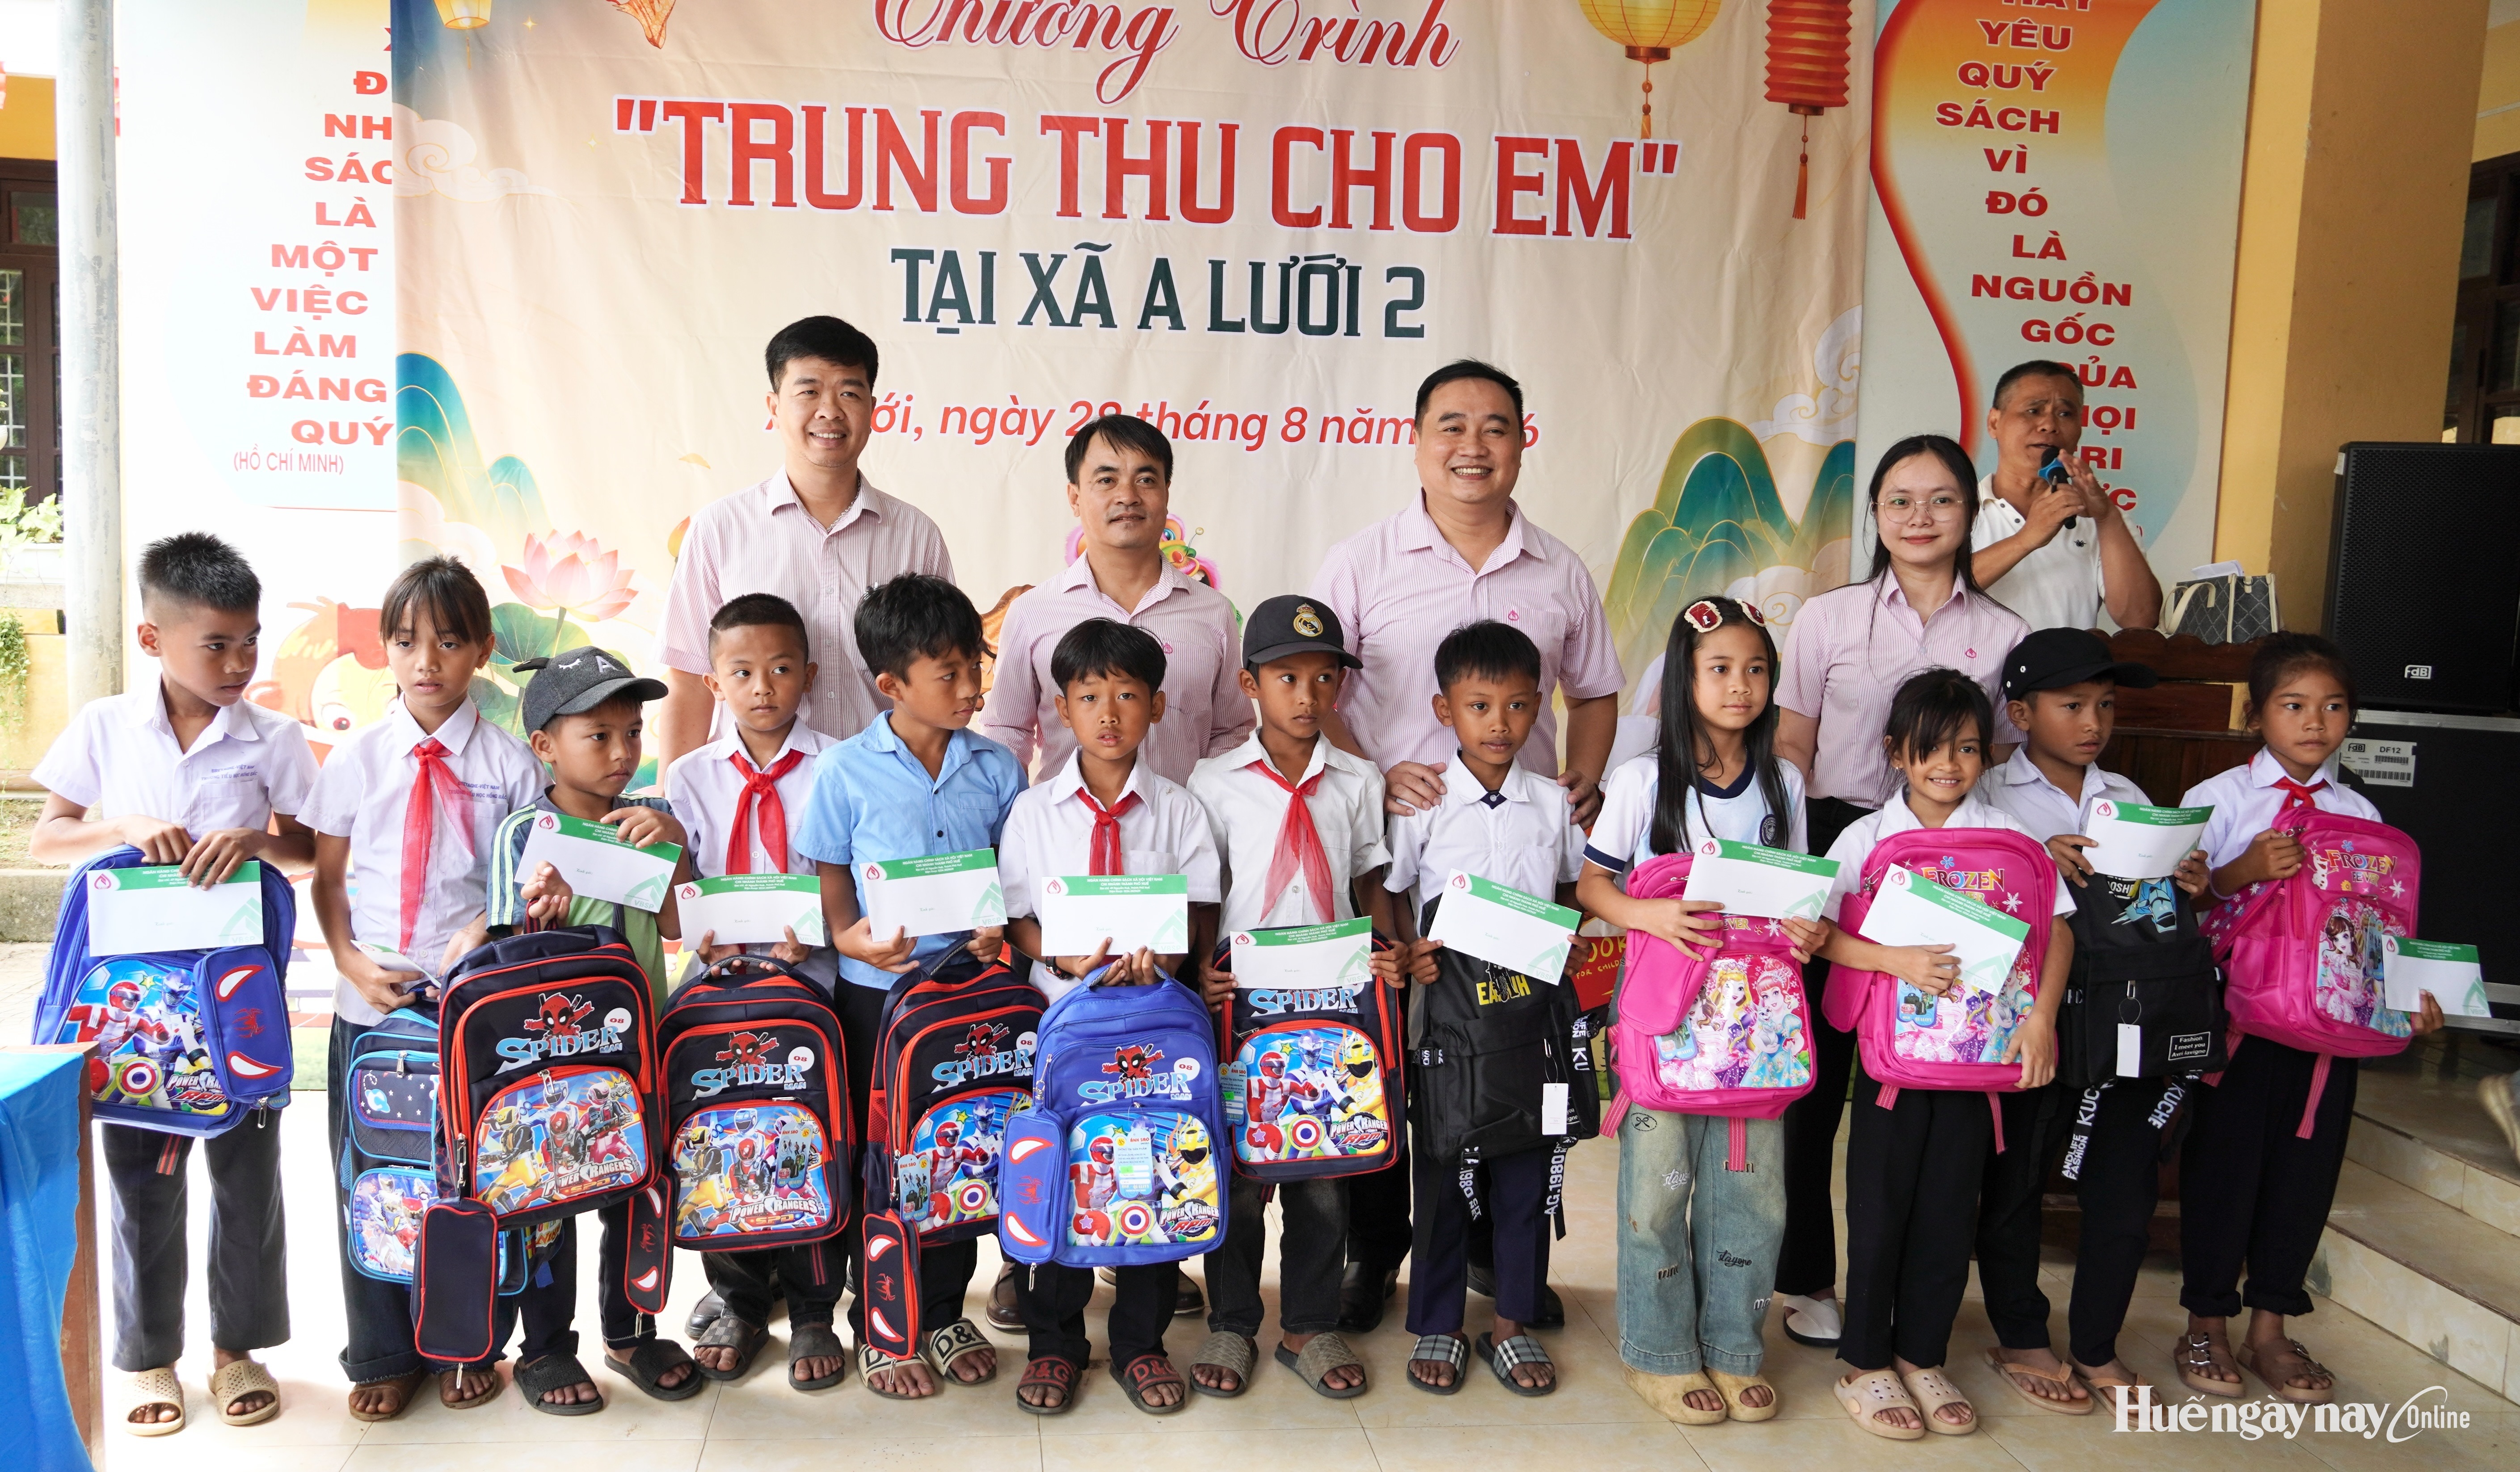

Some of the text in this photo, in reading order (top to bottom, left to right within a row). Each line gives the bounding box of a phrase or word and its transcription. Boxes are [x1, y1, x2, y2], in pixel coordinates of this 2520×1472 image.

[1977, 17, 2073, 51] YÊU
[1957, 60, 2056, 91] QUÝ
[1935, 98, 2060, 134] SÁCH
[304, 152, 392, 184] SÁC
[616, 99, 1678, 239] "TRUNG THU CHO EM"
[1983, 144, 2028, 173] VÌ
[315, 197, 377, 227] LÀ
[1985, 187, 2048, 216] ĐÓ
[271, 241, 378, 277] MỘT
[2012, 230, 2067, 261] LÀ
[250, 284, 368, 320] VIỆC
[891, 242, 1424, 337] TẠI XÃ A LƯỚI 2
[1971, 271, 2132, 306] NGUỒN
[255, 326, 356, 358] LÀM
[2021, 312, 2115, 346] GỐC
[247, 370, 387, 402] ĐÁNG
[2056, 355, 2137, 389] ỦA
[291, 416, 394, 446] QUÝ
[871, 392, 922, 441] ới,
[940, 395, 1056, 446] ngày
[1137, 400, 1268, 451] tháng
[1281, 407, 1307, 437] 8
[1319, 408, 1415, 445] năm
[234, 443, 344, 475] (HỒ CHÍ MINH)
[2073, 446, 2122, 470] RI
[2325, 849, 2397, 877] FROZEN
[1921, 867, 2005, 892] FROZEN
[634, 900, 654, 908] VBSP
[982, 917, 1001, 925] VBSP
[1347, 975, 1366, 983] VBSP
[1536, 971, 1554, 980] VBSP
[1576, 960, 1621, 979] FOR CHILD
[1974, 978, 1993, 990] VBSP
[1248, 988, 1357, 1017] SPIDER
[494, 1026, 621, 1075] SPIDER
[600, 1043, 623, 1053] MAN
[165, 1074, 198, 1090] POWER
[691, 1064, 805, 1101] SPIDER
[784, 1081, 807, 1090] MAN
[931, 1049, 1032, 1093] SPIDER
[1014, 1067, 1033, 1076] MAN
[1078, 1072, 1191, 1107] SPIDER
[2077, 1088, 2100, 1127] KUC
[2148, 1082, 2186, 1129] KUCHE
[1330, 1123, 1354, 1138] POWER
[2068, 1135, 2088, 1181] FASHION
[543, 1158, 634, 1197] POWER RANGERS
[571, 1179, 611, 1193] SPD
[730, 1199, 819, 1223] POWER RANGERS
[754, 1215, 794, 1225] SPD
[1161, 1208, 1184, 1224] POWER
